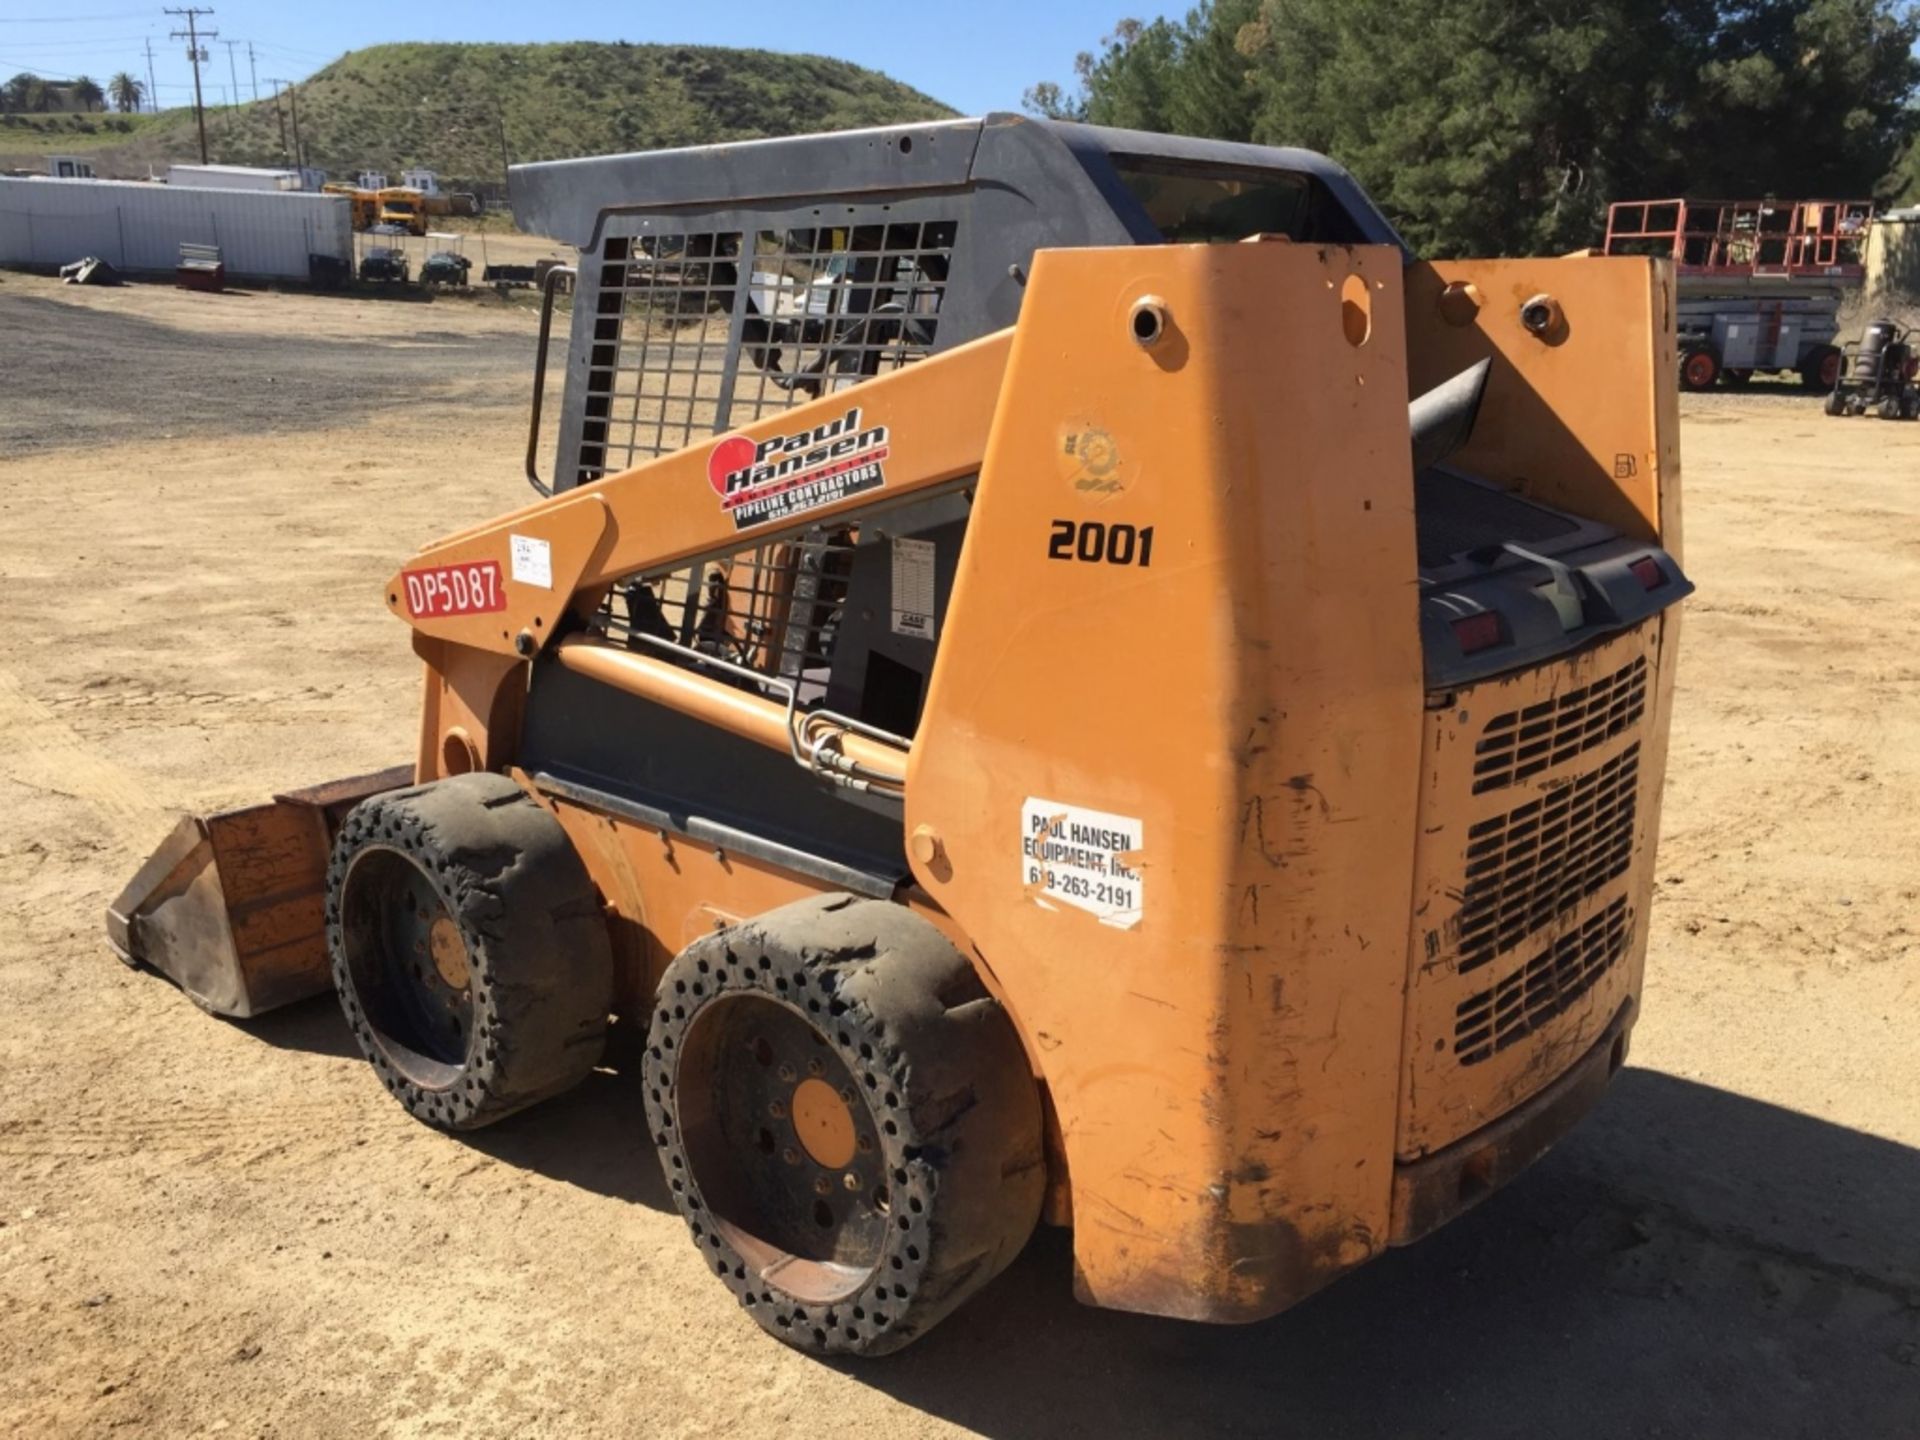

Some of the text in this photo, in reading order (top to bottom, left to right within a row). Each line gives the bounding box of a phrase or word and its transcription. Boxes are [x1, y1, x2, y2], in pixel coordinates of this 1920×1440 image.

[726, 427, 885, 494] Hansen
[755, 408, 860, 462] Paul
[735, 466, 878, 521] PIPELINE CONTRACTORS
[1048, 519, 1153, 567] 2001
[407, 566, 496, 614] DP5D87
[1032, 815, 1131, 852] PAUL HANSEN
